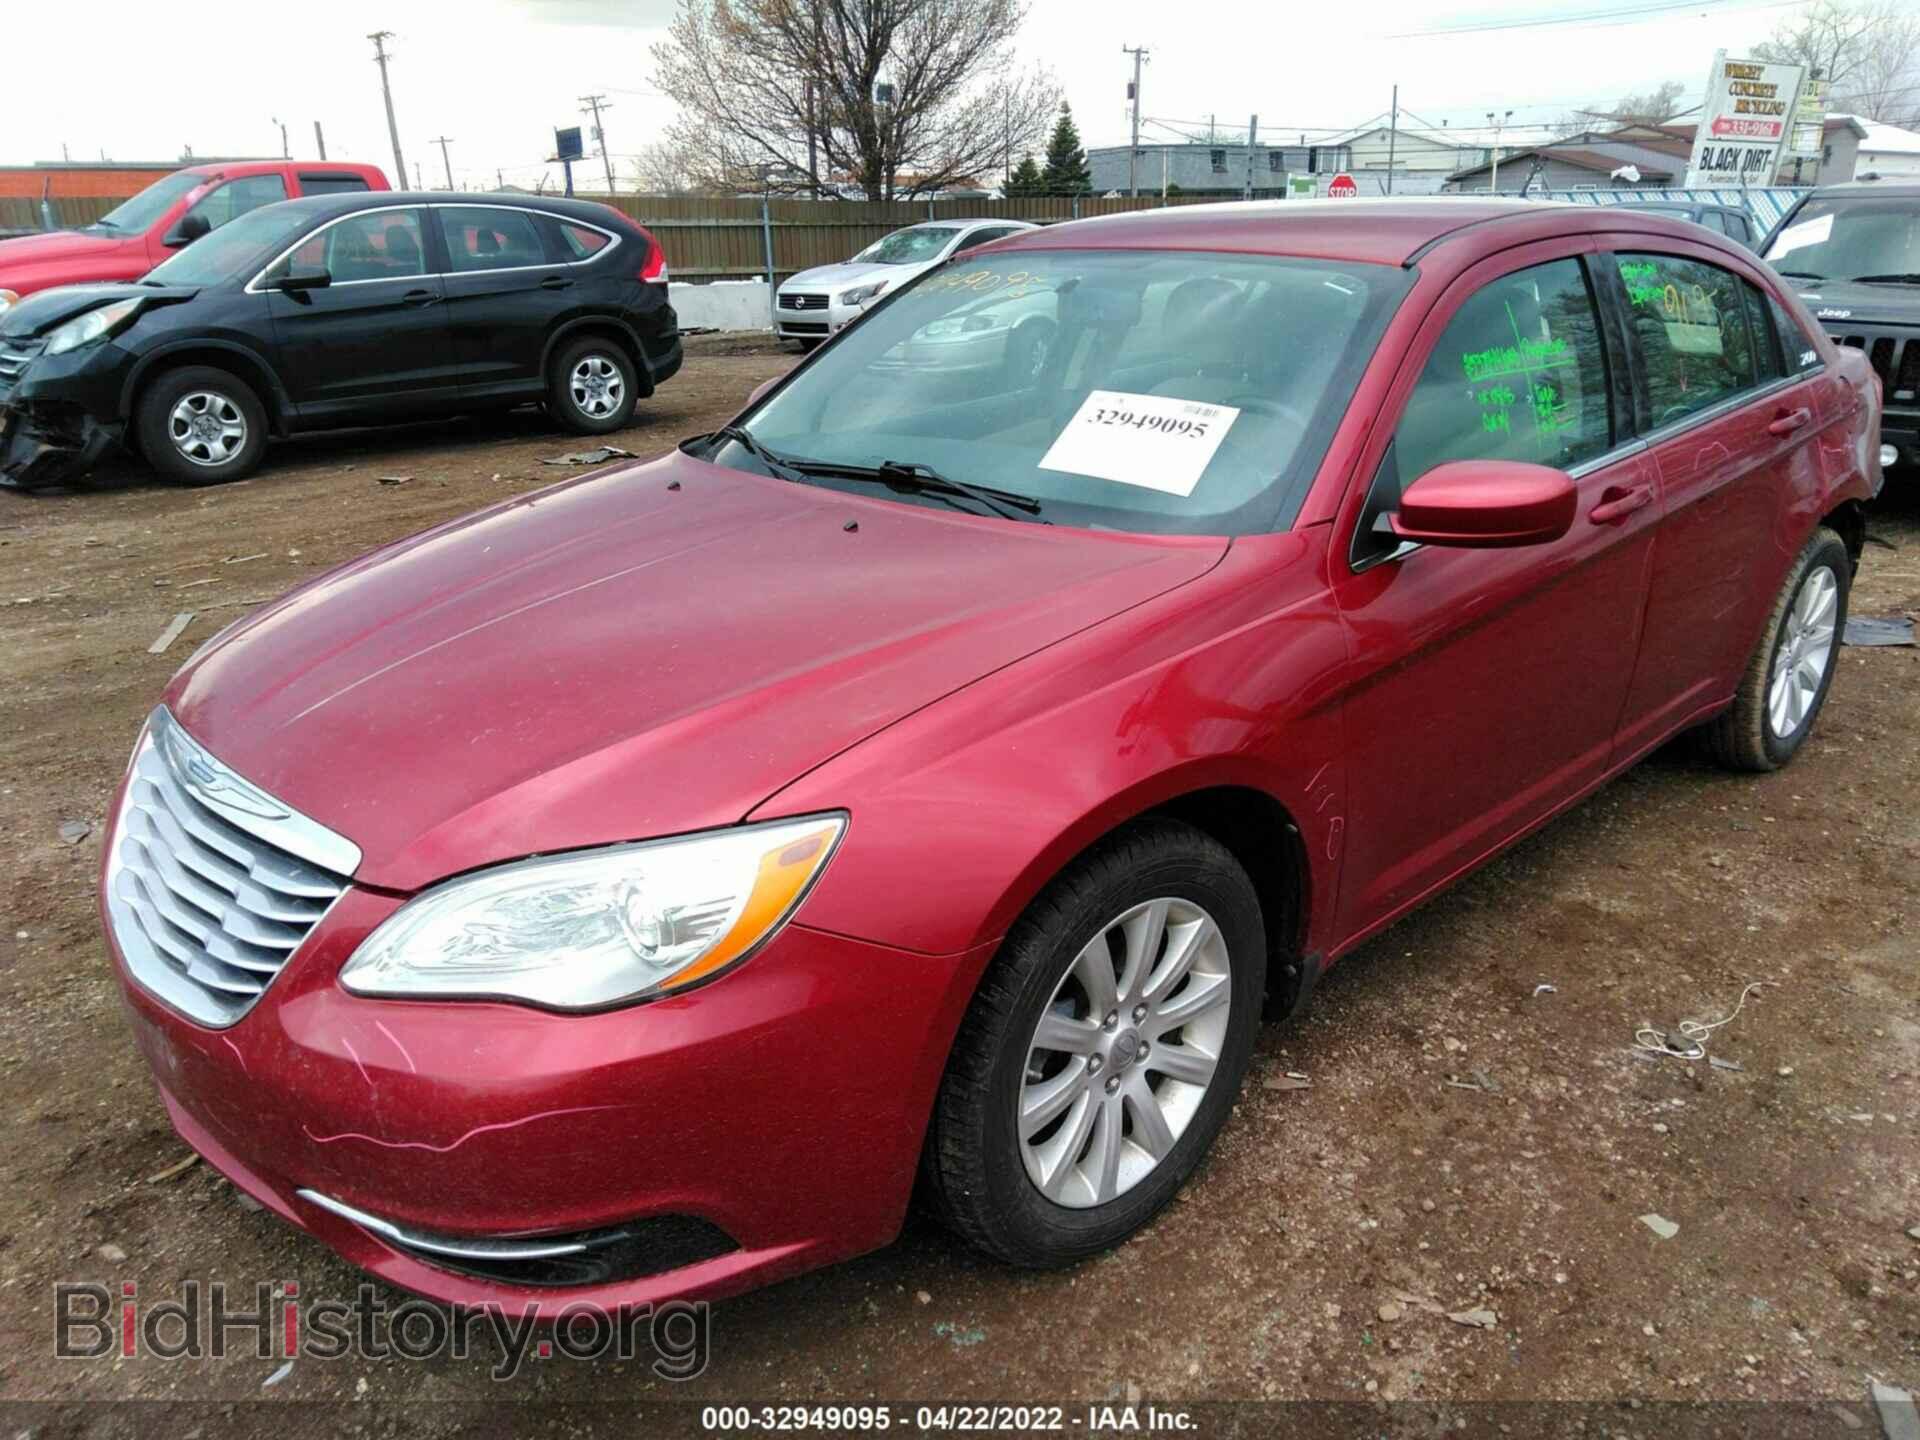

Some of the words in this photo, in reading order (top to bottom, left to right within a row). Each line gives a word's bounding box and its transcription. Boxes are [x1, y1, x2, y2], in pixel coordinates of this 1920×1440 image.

[1699, 147, 1742, 172] BLACK
[1743, 149, 1771, 172] DIRT
[1329, 186, 1356, 199] STOP
[1817, 308, 1851, 318] Jeep
[1087, 409, 1208, 439] 32949095
